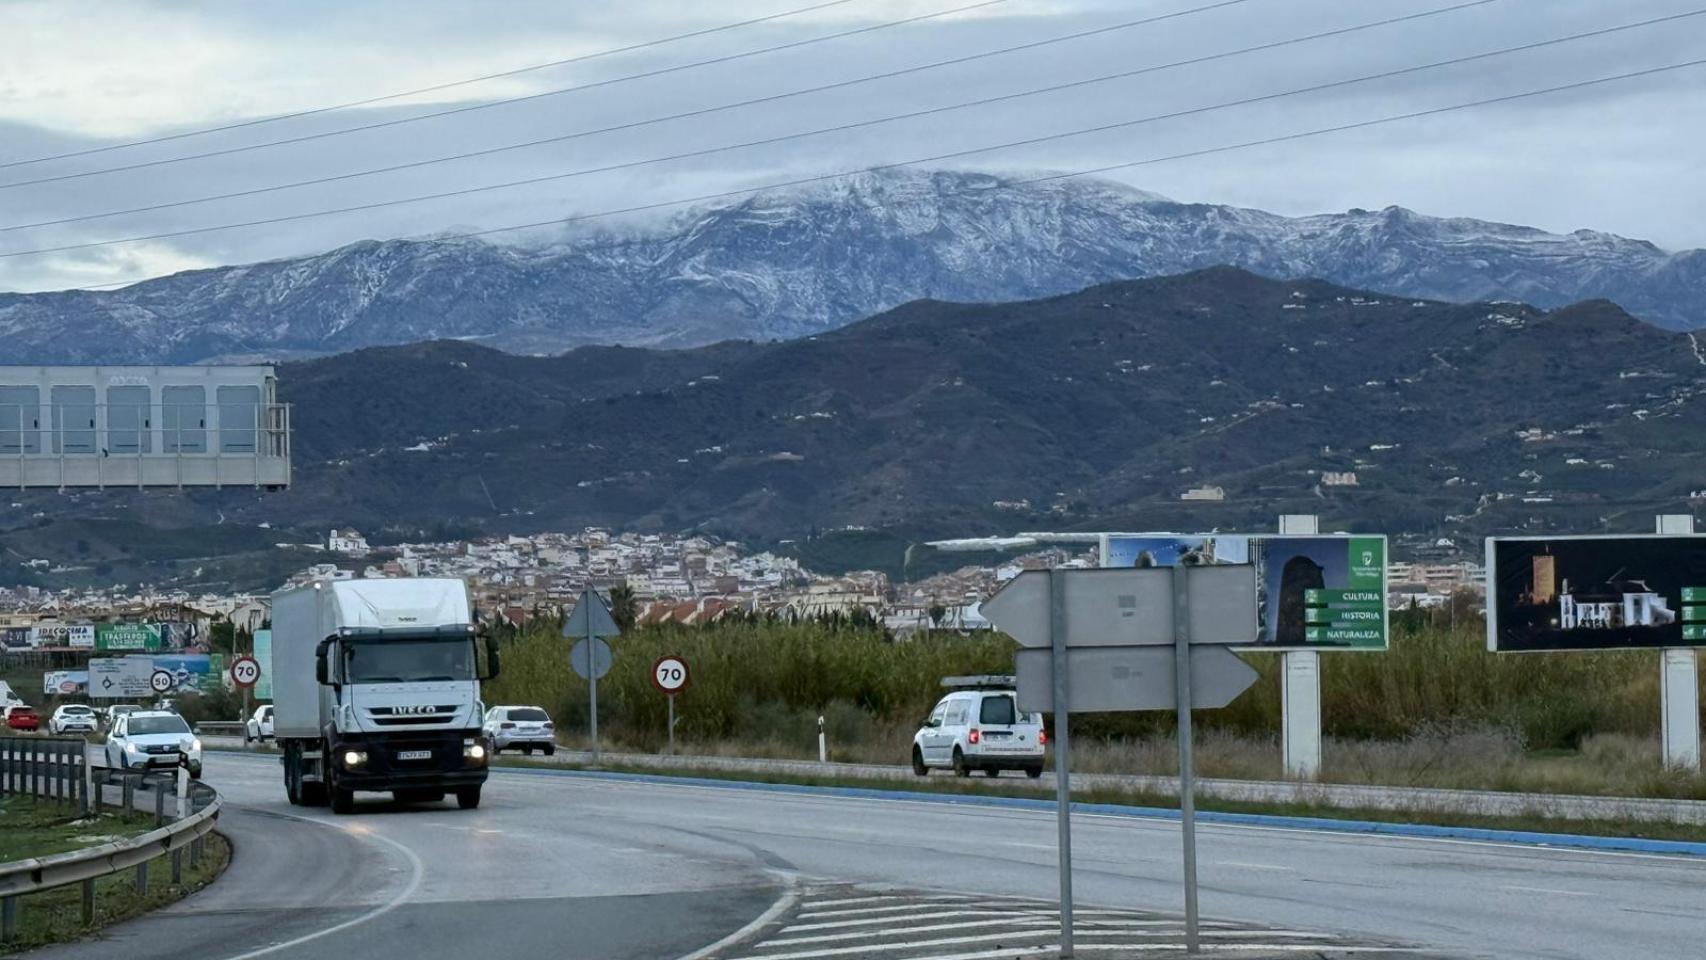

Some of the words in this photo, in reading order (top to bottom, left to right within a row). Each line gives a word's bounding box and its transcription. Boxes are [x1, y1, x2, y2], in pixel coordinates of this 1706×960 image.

[1342, 592, 1380, 600] CULTURA
[1341, 611, 1380, 619] HISTORIA
[1327, 631, 1380, 639] NATURALEZA
[237, 666, 255, 677] 70
[660, 668, 682, 682] 70
[154, 677, 169, 686] 50
[392, 705, 436, 716] IVECO
